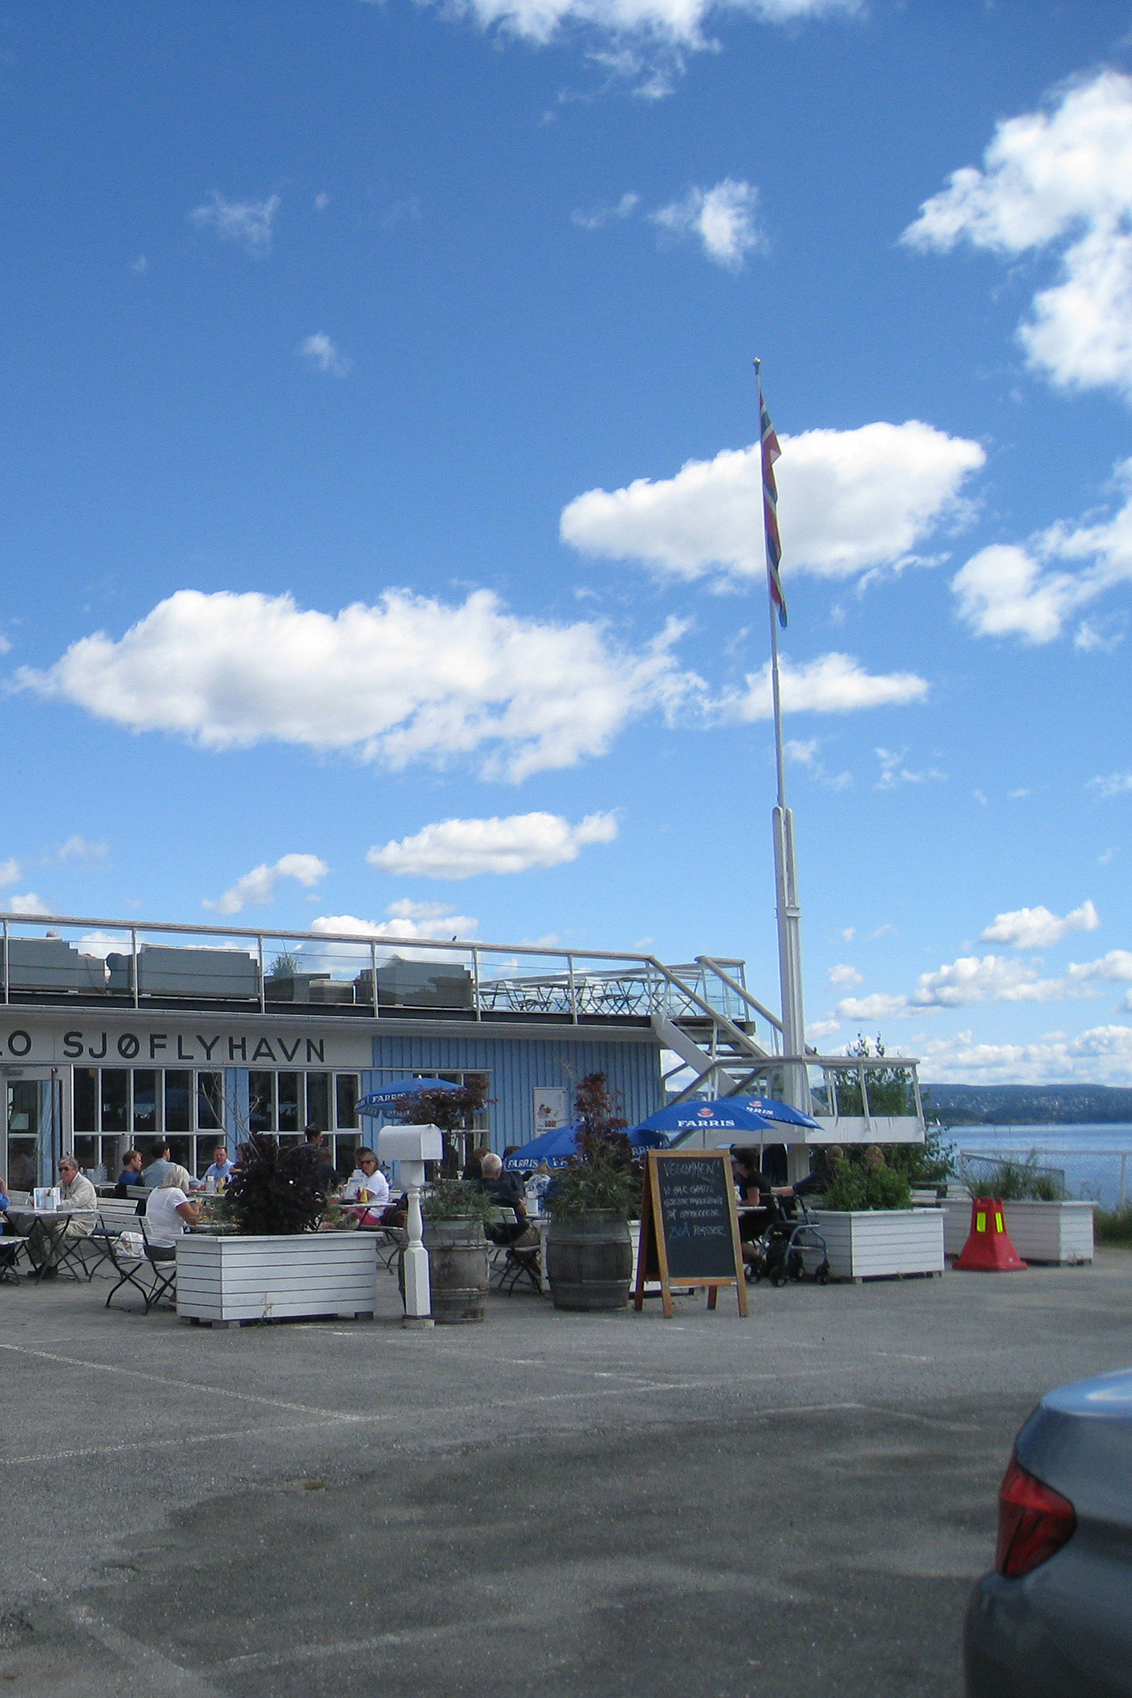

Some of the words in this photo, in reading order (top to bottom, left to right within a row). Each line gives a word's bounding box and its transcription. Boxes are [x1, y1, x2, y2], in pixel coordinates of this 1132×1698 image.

[63, 1030, 325, 1063] SJØFLYHAVN
[677, 1119, 736, 1128] FARRIS
[507, 1158, 539, 1169] FARRIS
